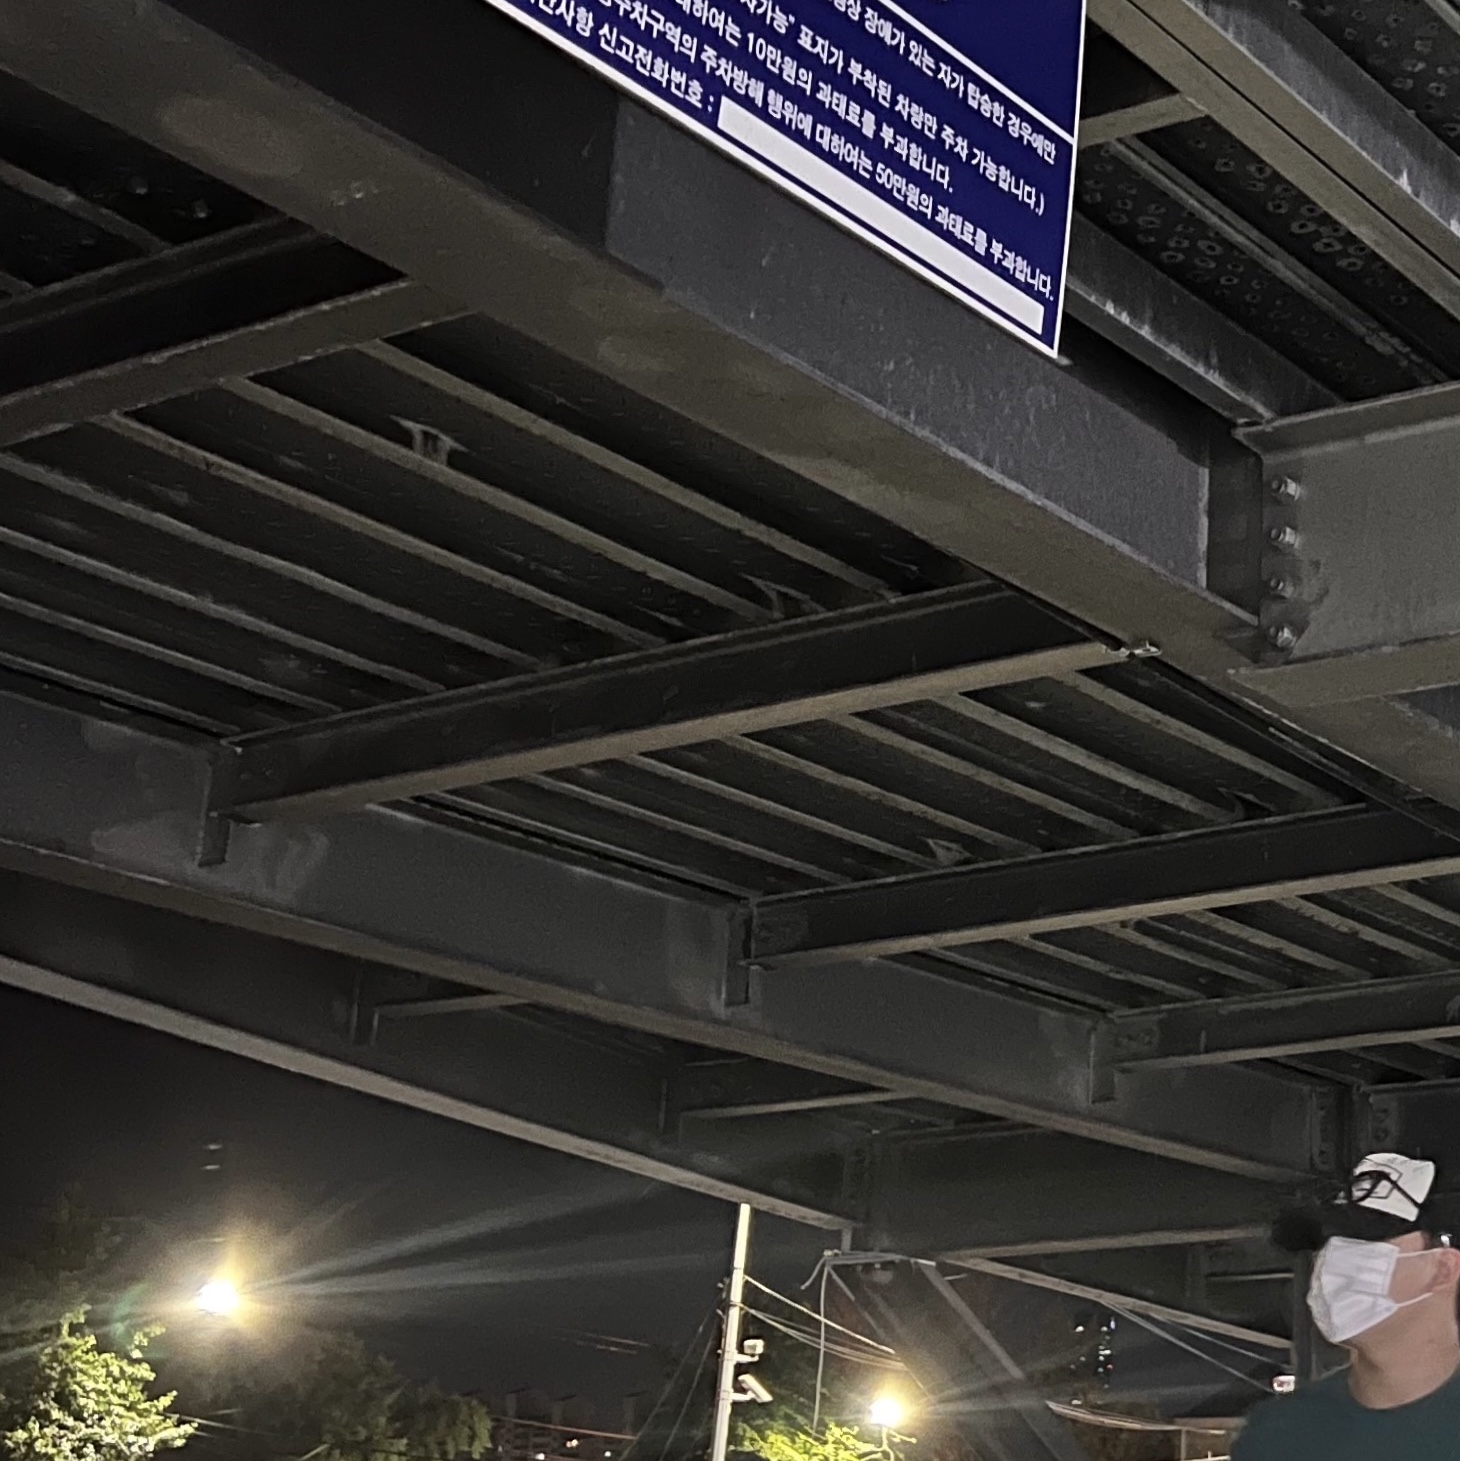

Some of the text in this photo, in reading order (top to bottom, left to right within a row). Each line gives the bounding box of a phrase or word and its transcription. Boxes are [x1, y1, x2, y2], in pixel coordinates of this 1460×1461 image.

[598, 22, 703, 109] 신고전화번호
[747, 32, 813, 96] 10만원의
[816, 81, 876, 139] 과태료를
[880, 122, 953, 193] 부과합니다.
[797, 23, 844, 74] 표지가
[847, 57, 892, 108] 부착된
[894, 93, 938, 140] 차량만
[940, 123, 969, 162] 주차
[971, 147, 1045, 216] 가능합니다.)
[864, 6, 906, 55] 장애가
[908, 39, 936, 77] 있는
[937, 61, 965, 99] 자가
[967, 82, 1005, 127] 탑승한
[1007, 111, 1057, 165] 경우에만
[599, 0, 1054, 301] 주차구역의 주차방해 행위에 대하여는 50만원의 과태료를 부과합니다.
